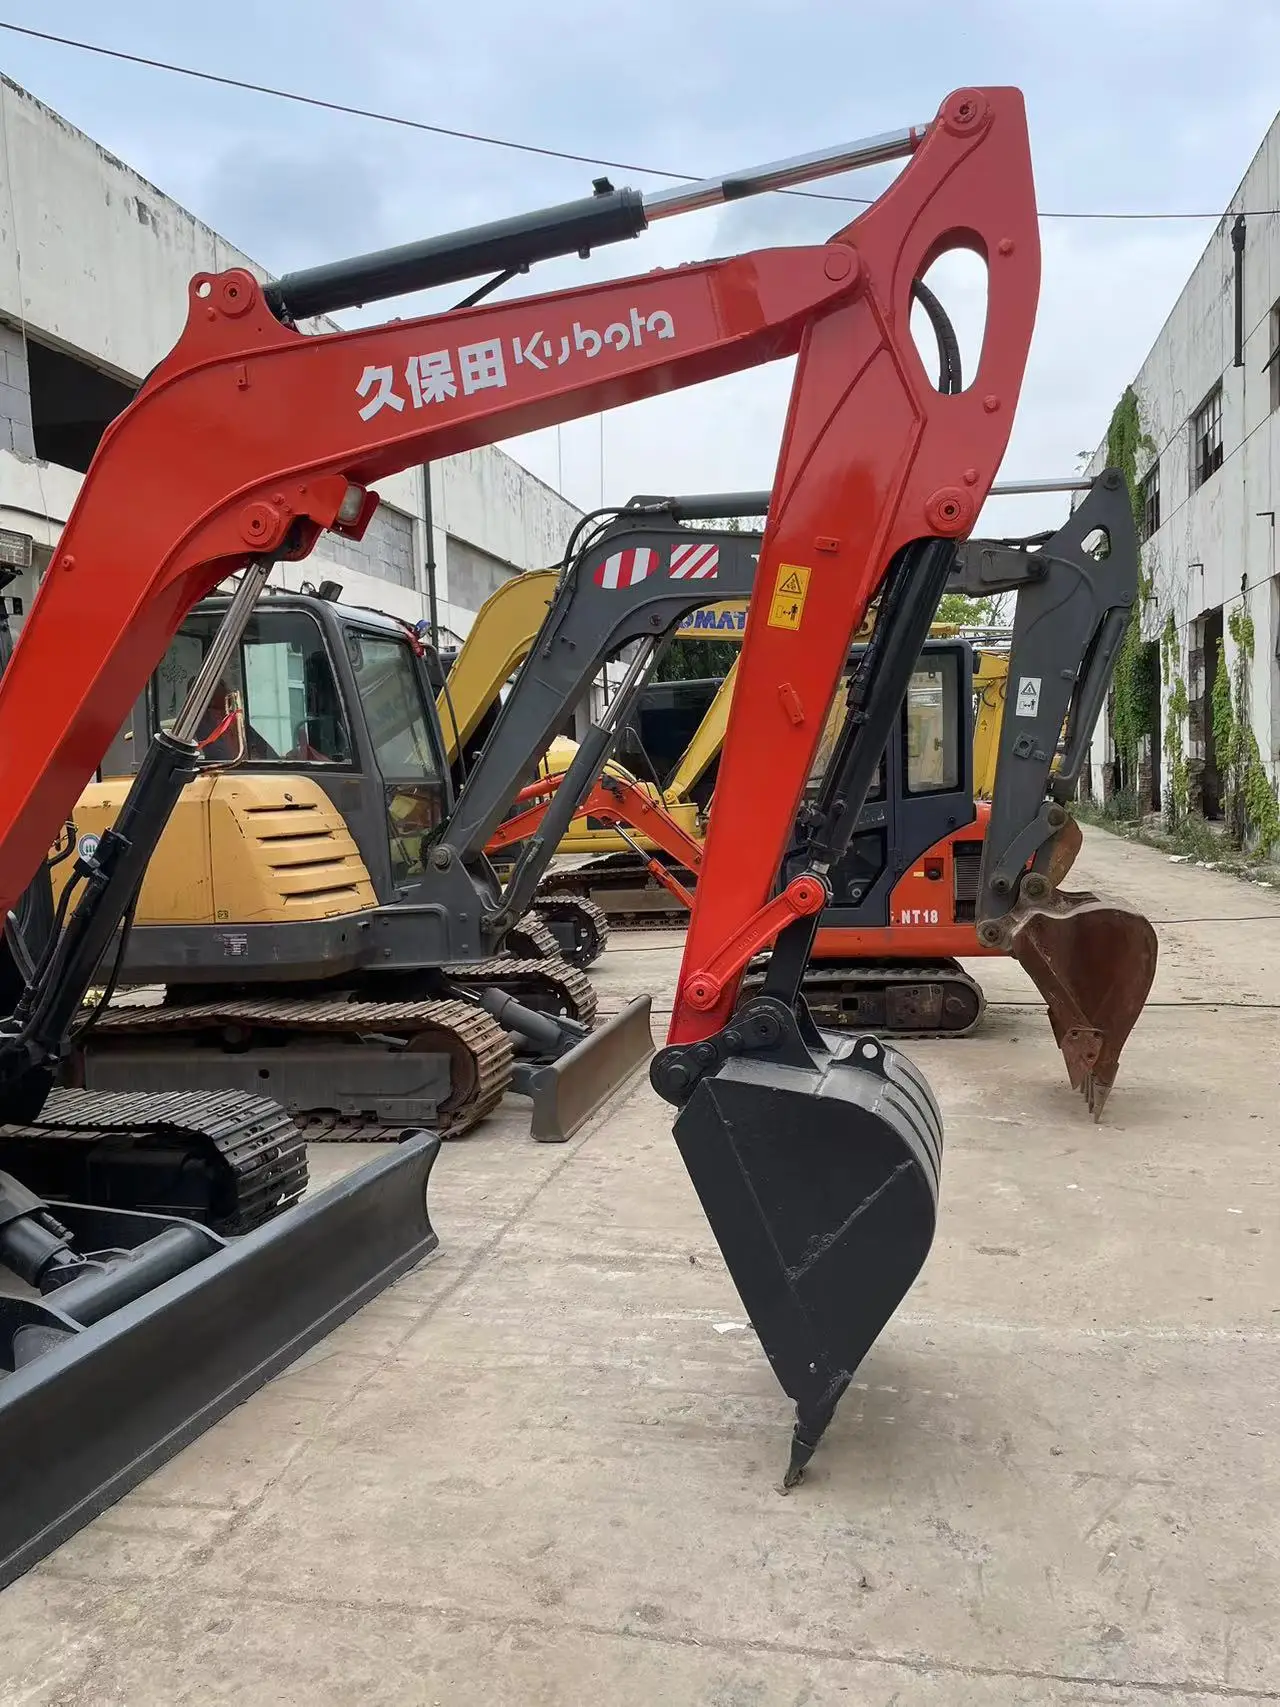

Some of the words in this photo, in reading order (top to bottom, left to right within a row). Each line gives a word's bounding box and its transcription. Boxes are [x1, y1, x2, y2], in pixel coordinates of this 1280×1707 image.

[355, 337, 507, 422] 久保田
[512, 307, 675, 370] Kubota
